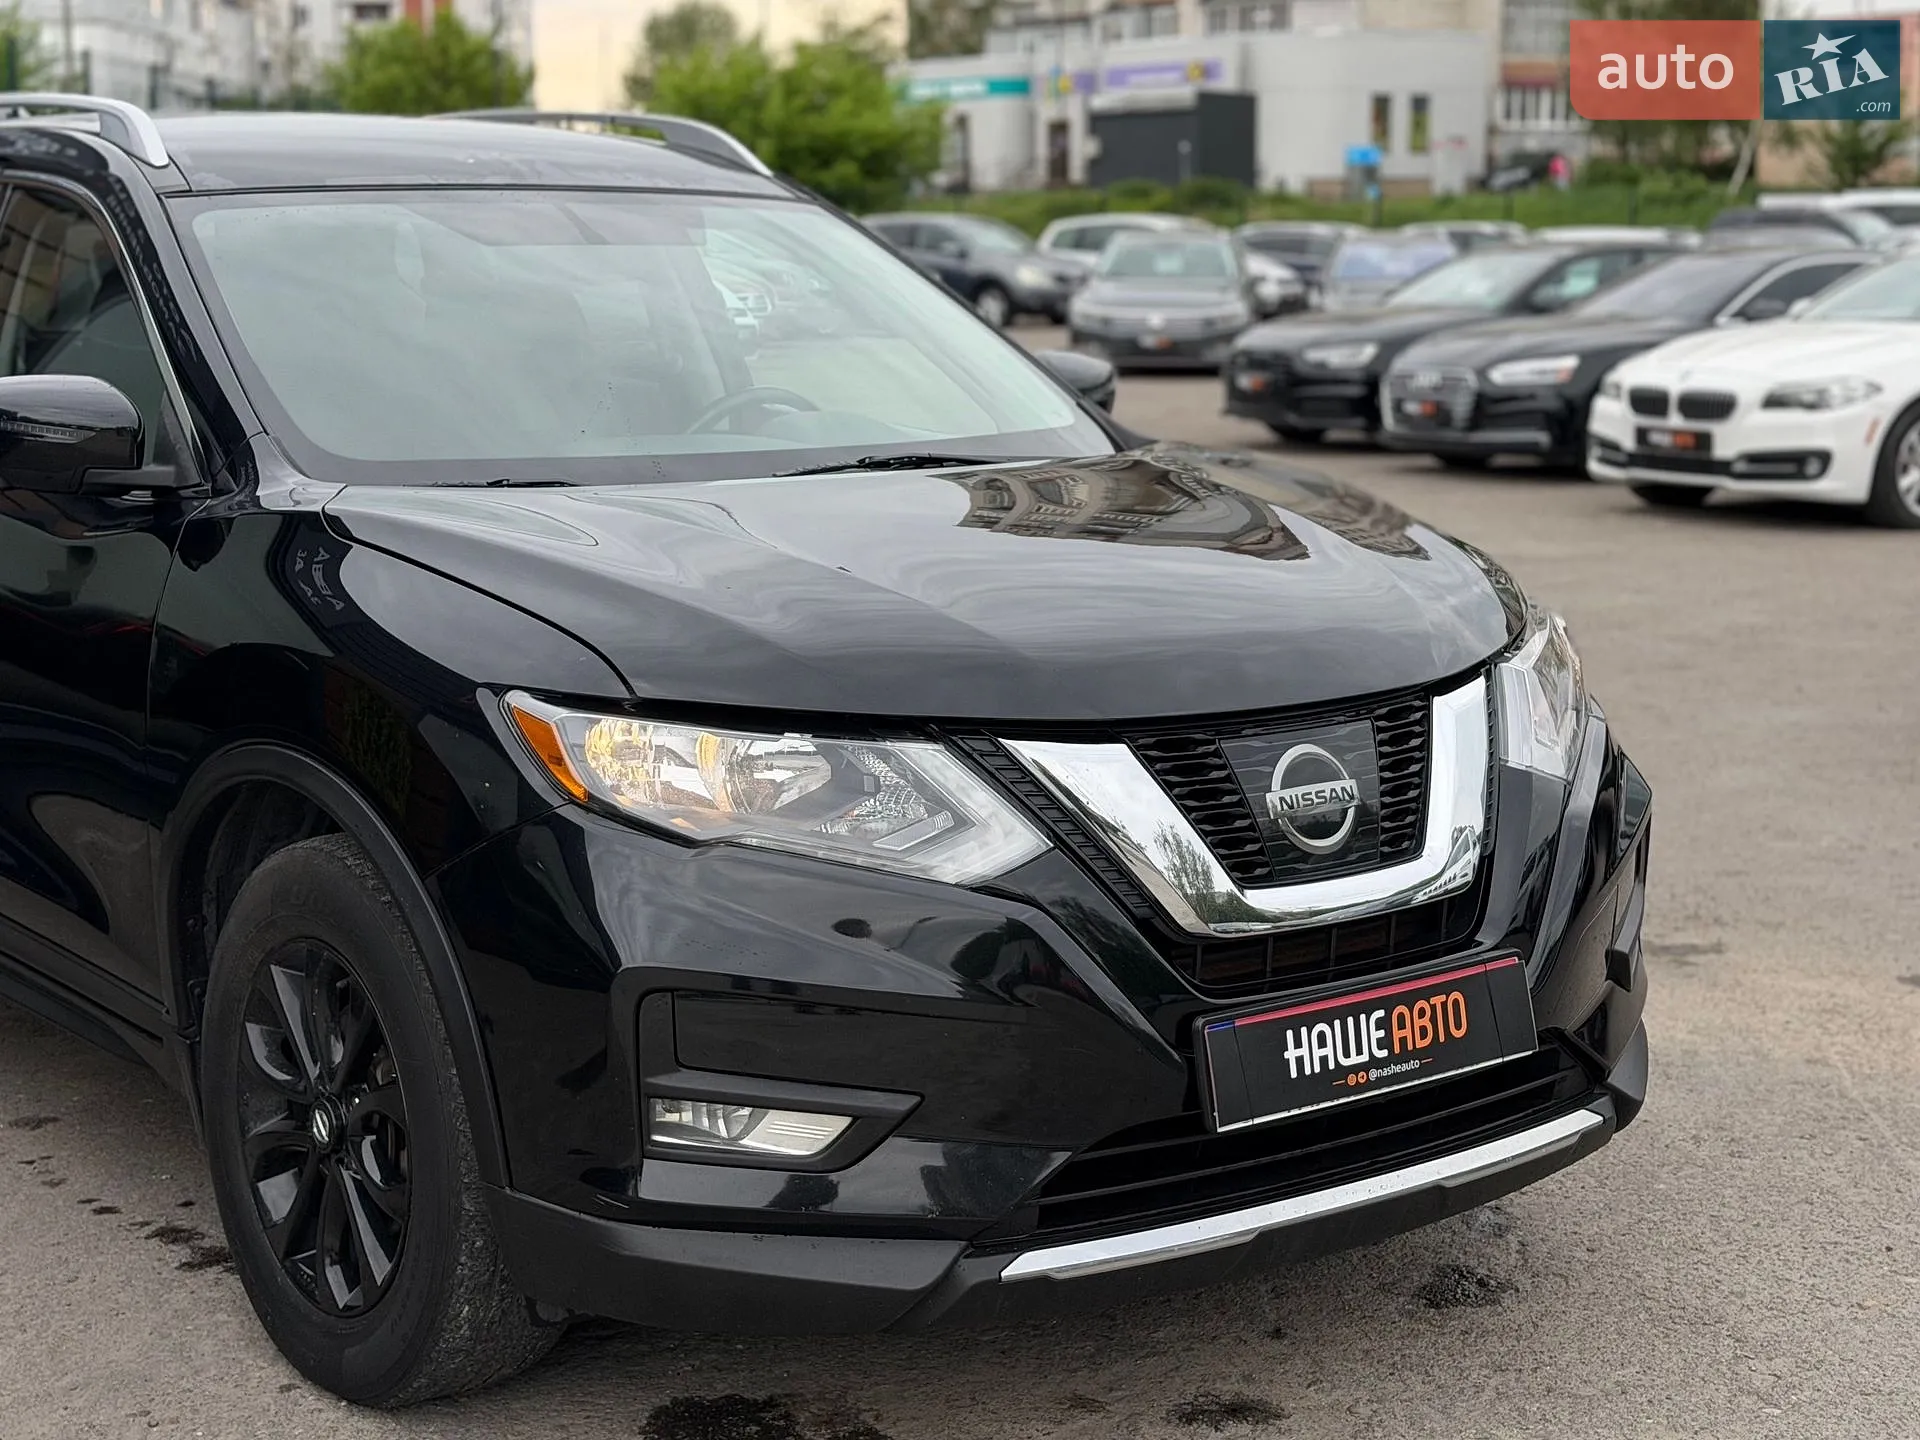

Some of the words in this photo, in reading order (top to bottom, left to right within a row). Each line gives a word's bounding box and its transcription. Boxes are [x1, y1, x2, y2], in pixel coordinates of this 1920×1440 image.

[1278, 785, 1355, 811] NISSAN
[1284, 1009, 1388, 1079] НАШЕ
[1391, 991, 1467, 1055] АВТО
[1368, 1058, 1420, 1081] @nasheauto
